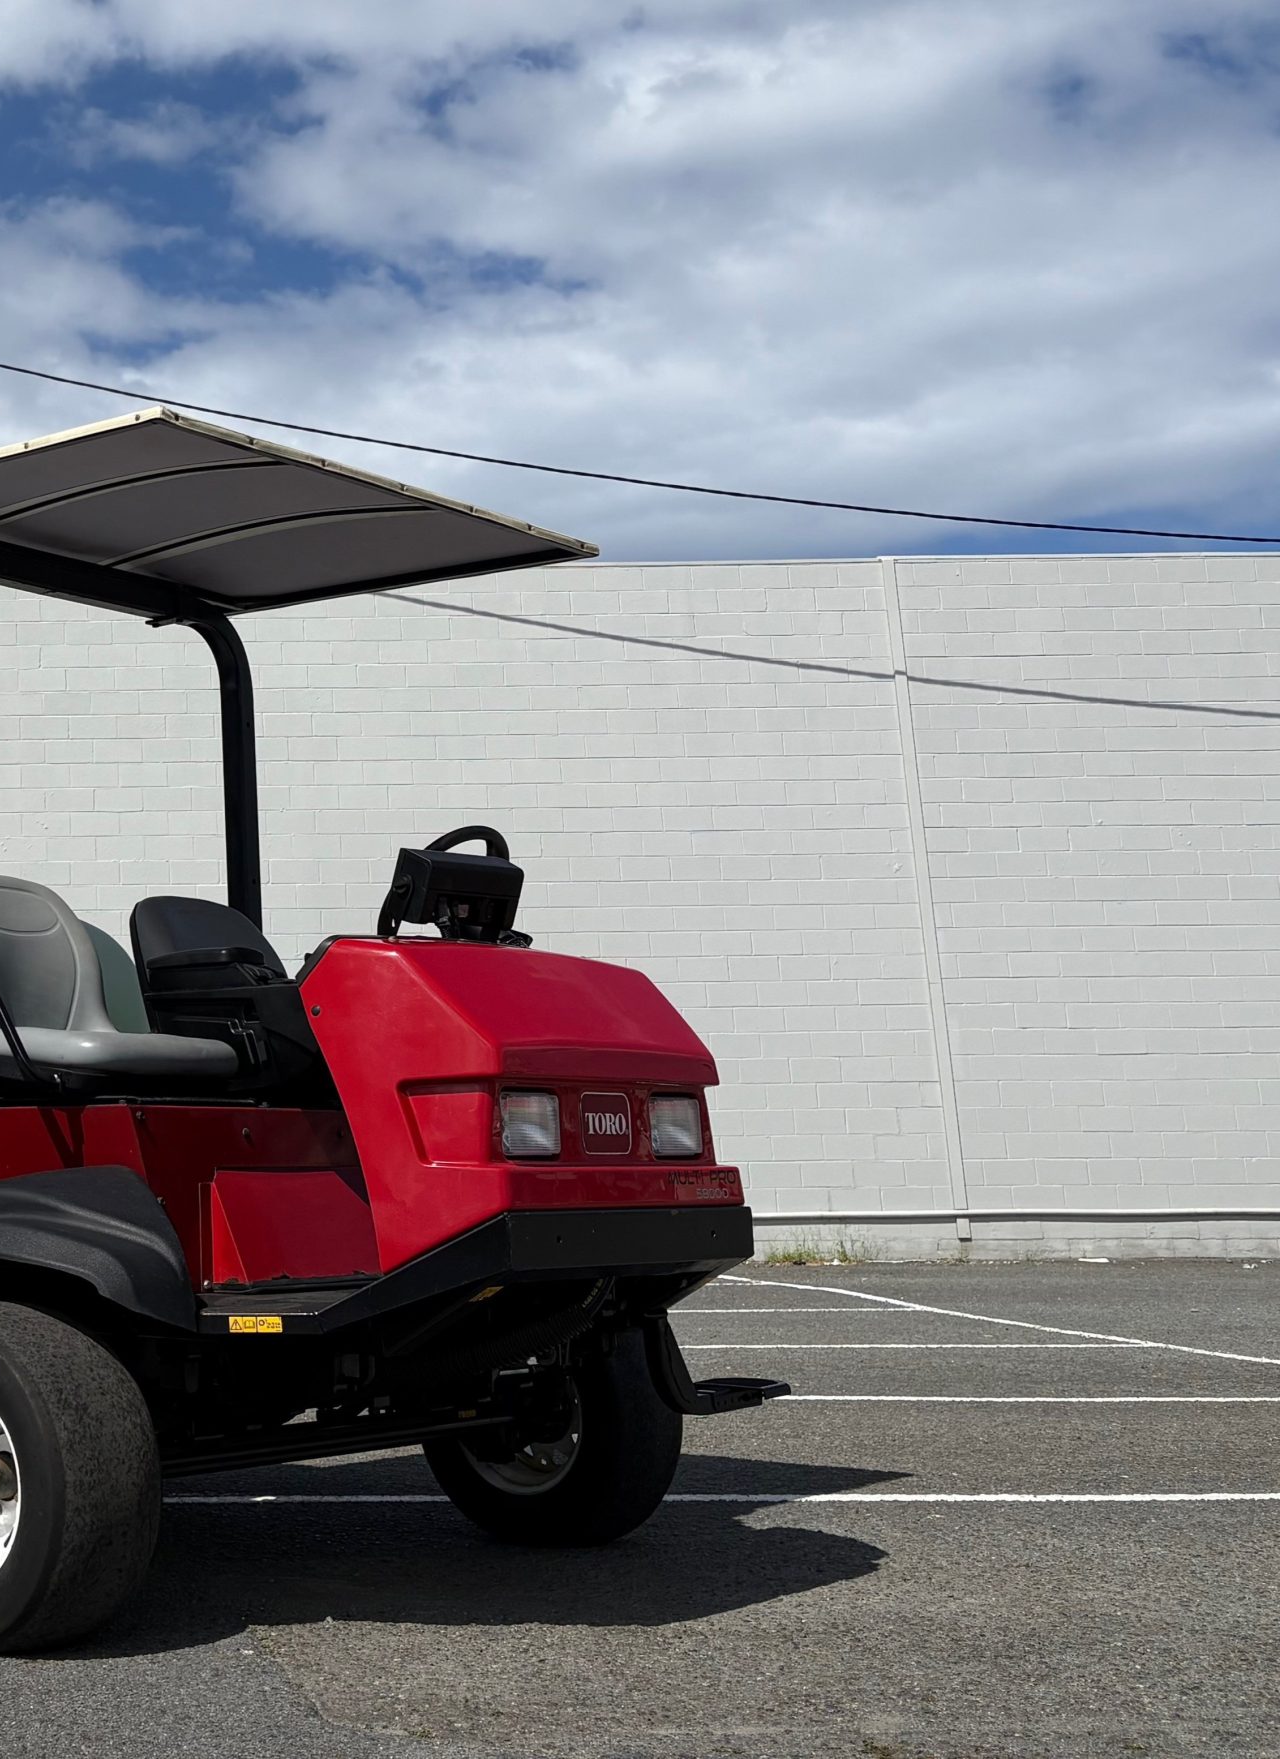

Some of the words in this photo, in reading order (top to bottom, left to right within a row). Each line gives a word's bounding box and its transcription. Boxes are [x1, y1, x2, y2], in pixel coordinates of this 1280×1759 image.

[585, 1112, 627, 1135] TORO
[668, 1170, 703, 1184] MULTI
[709, 1169, 736, 1184] PRO
